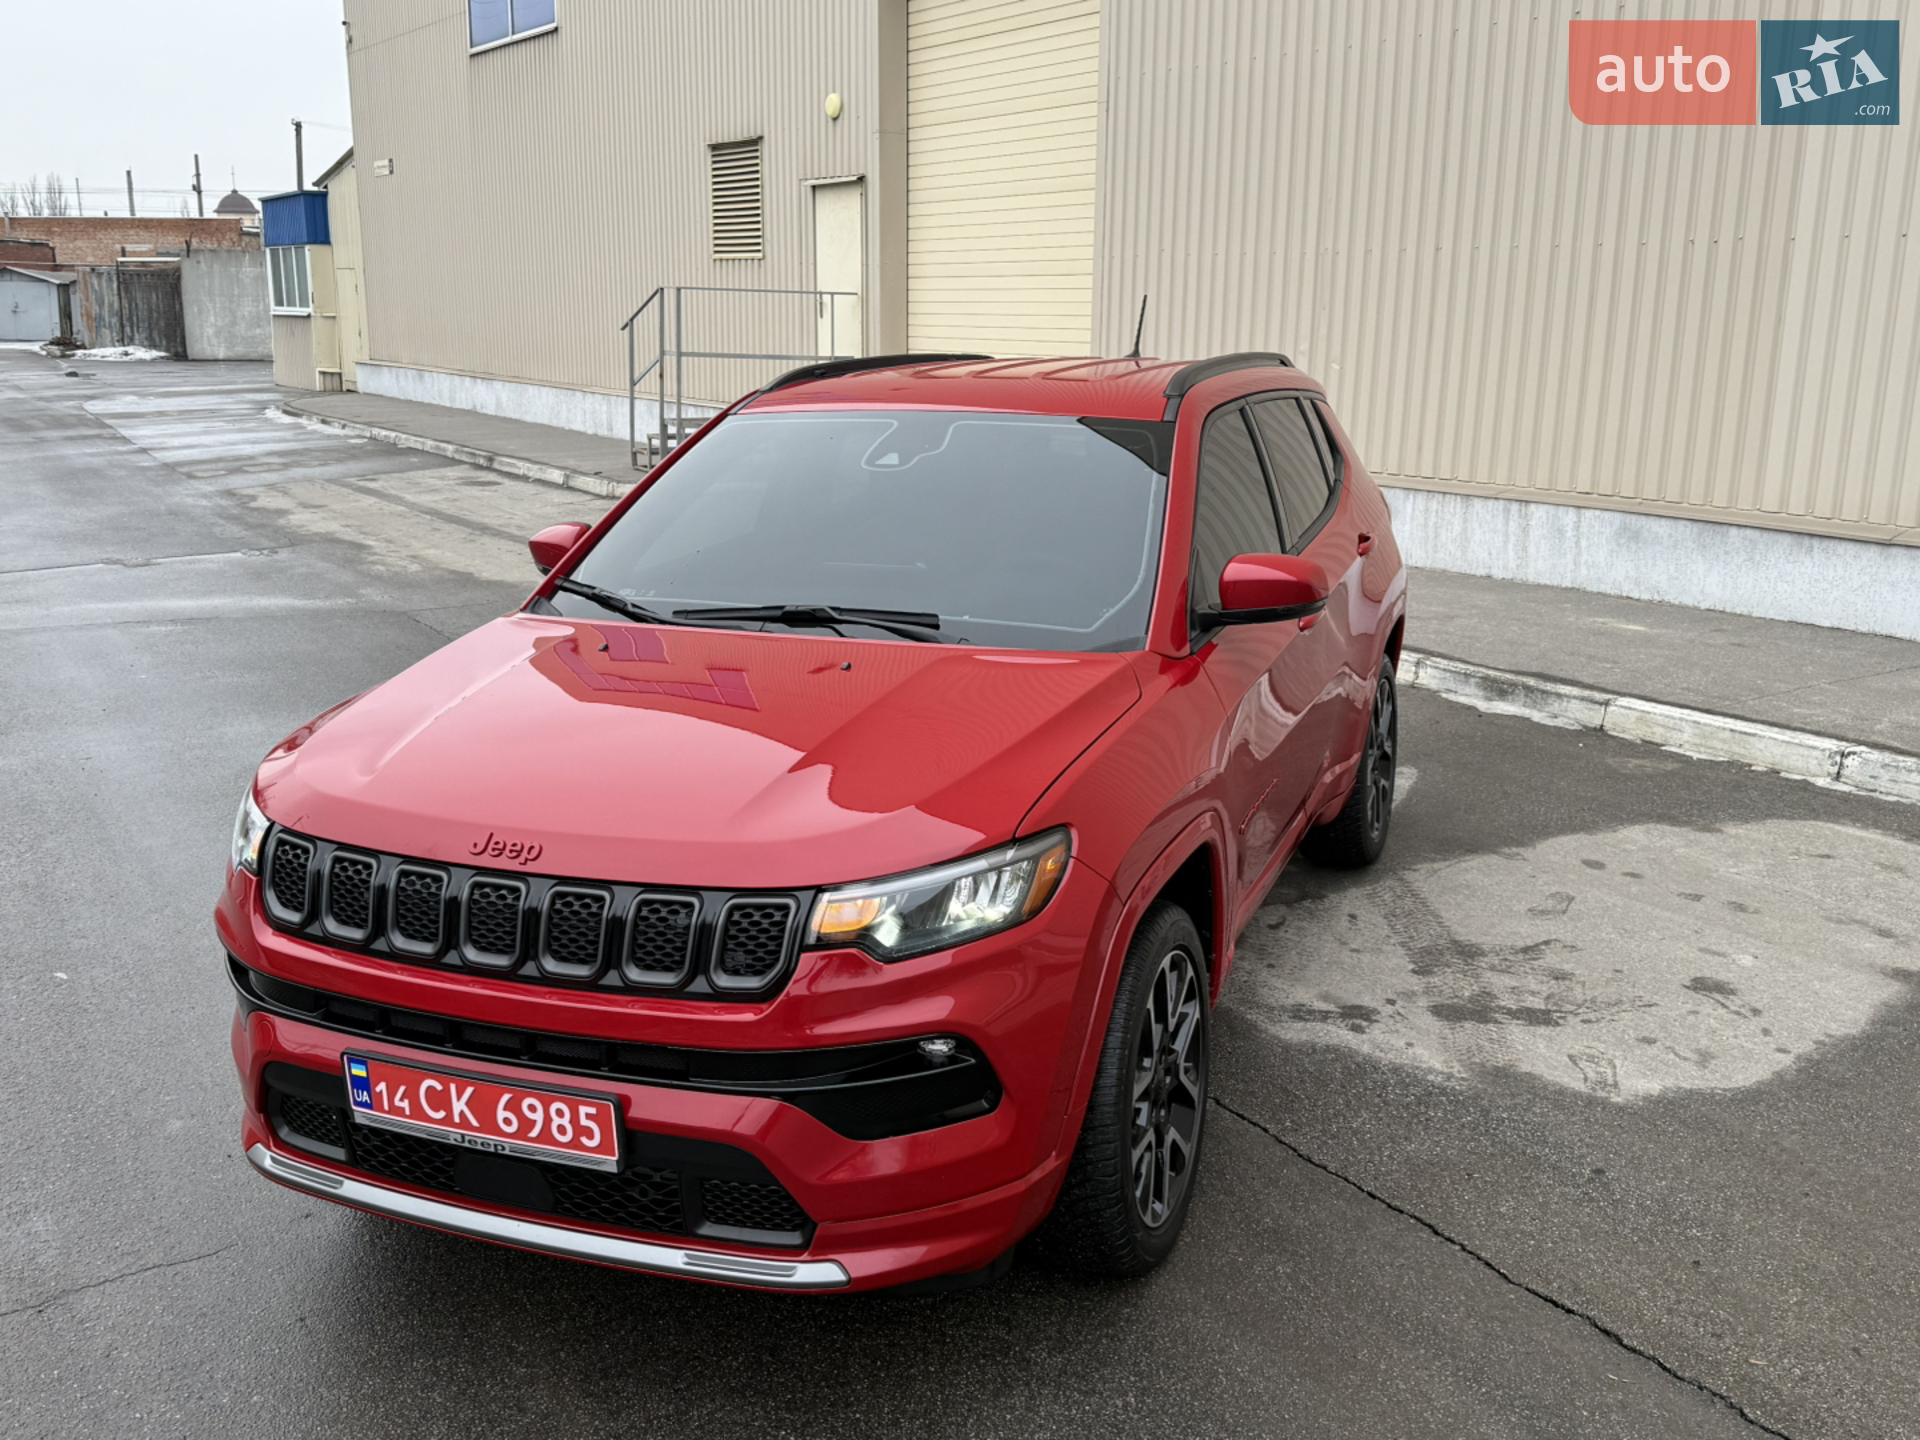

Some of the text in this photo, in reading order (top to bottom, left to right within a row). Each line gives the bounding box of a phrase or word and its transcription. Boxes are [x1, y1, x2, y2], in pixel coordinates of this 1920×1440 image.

[468, 832, 543, 865] Jeep
[354, 1088, 371, 1104] UA
[375, 1079, 601, 1148] 14 CK 6985
[453, 1134, 506, 1153] Jeep
